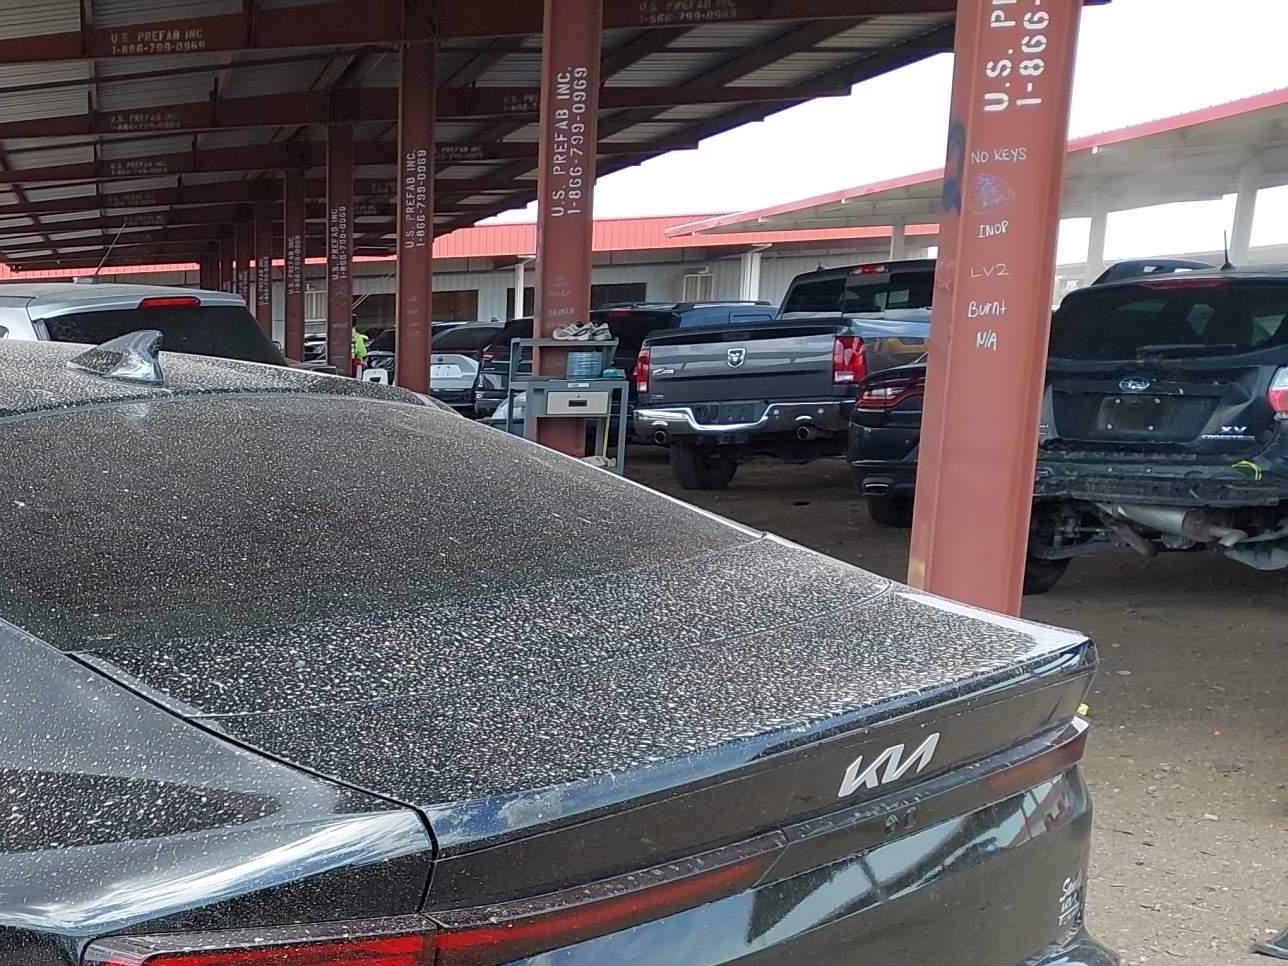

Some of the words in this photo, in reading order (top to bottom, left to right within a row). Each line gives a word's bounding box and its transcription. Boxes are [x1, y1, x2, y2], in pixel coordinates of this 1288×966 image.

[555, 67, 572, 100] INC.
[552, 108, 569, 175] PREFAB
[567, 67, 588, 214] 1-866-799-0969
[970, 151, 990, 165] NO
[994, 147, 1028, 163] KEYS
[405, 177, 416, 221] PREFAB
[551, 184, 566, 217] U.S.
[976, 220, 1010, 239] INOP
[970, 263, 1011, 279] LV2
[967, 300, 1008, 318] Burnt
[975, 330, 998, 351] N/A
[837, 732, 941, 798] KIA
